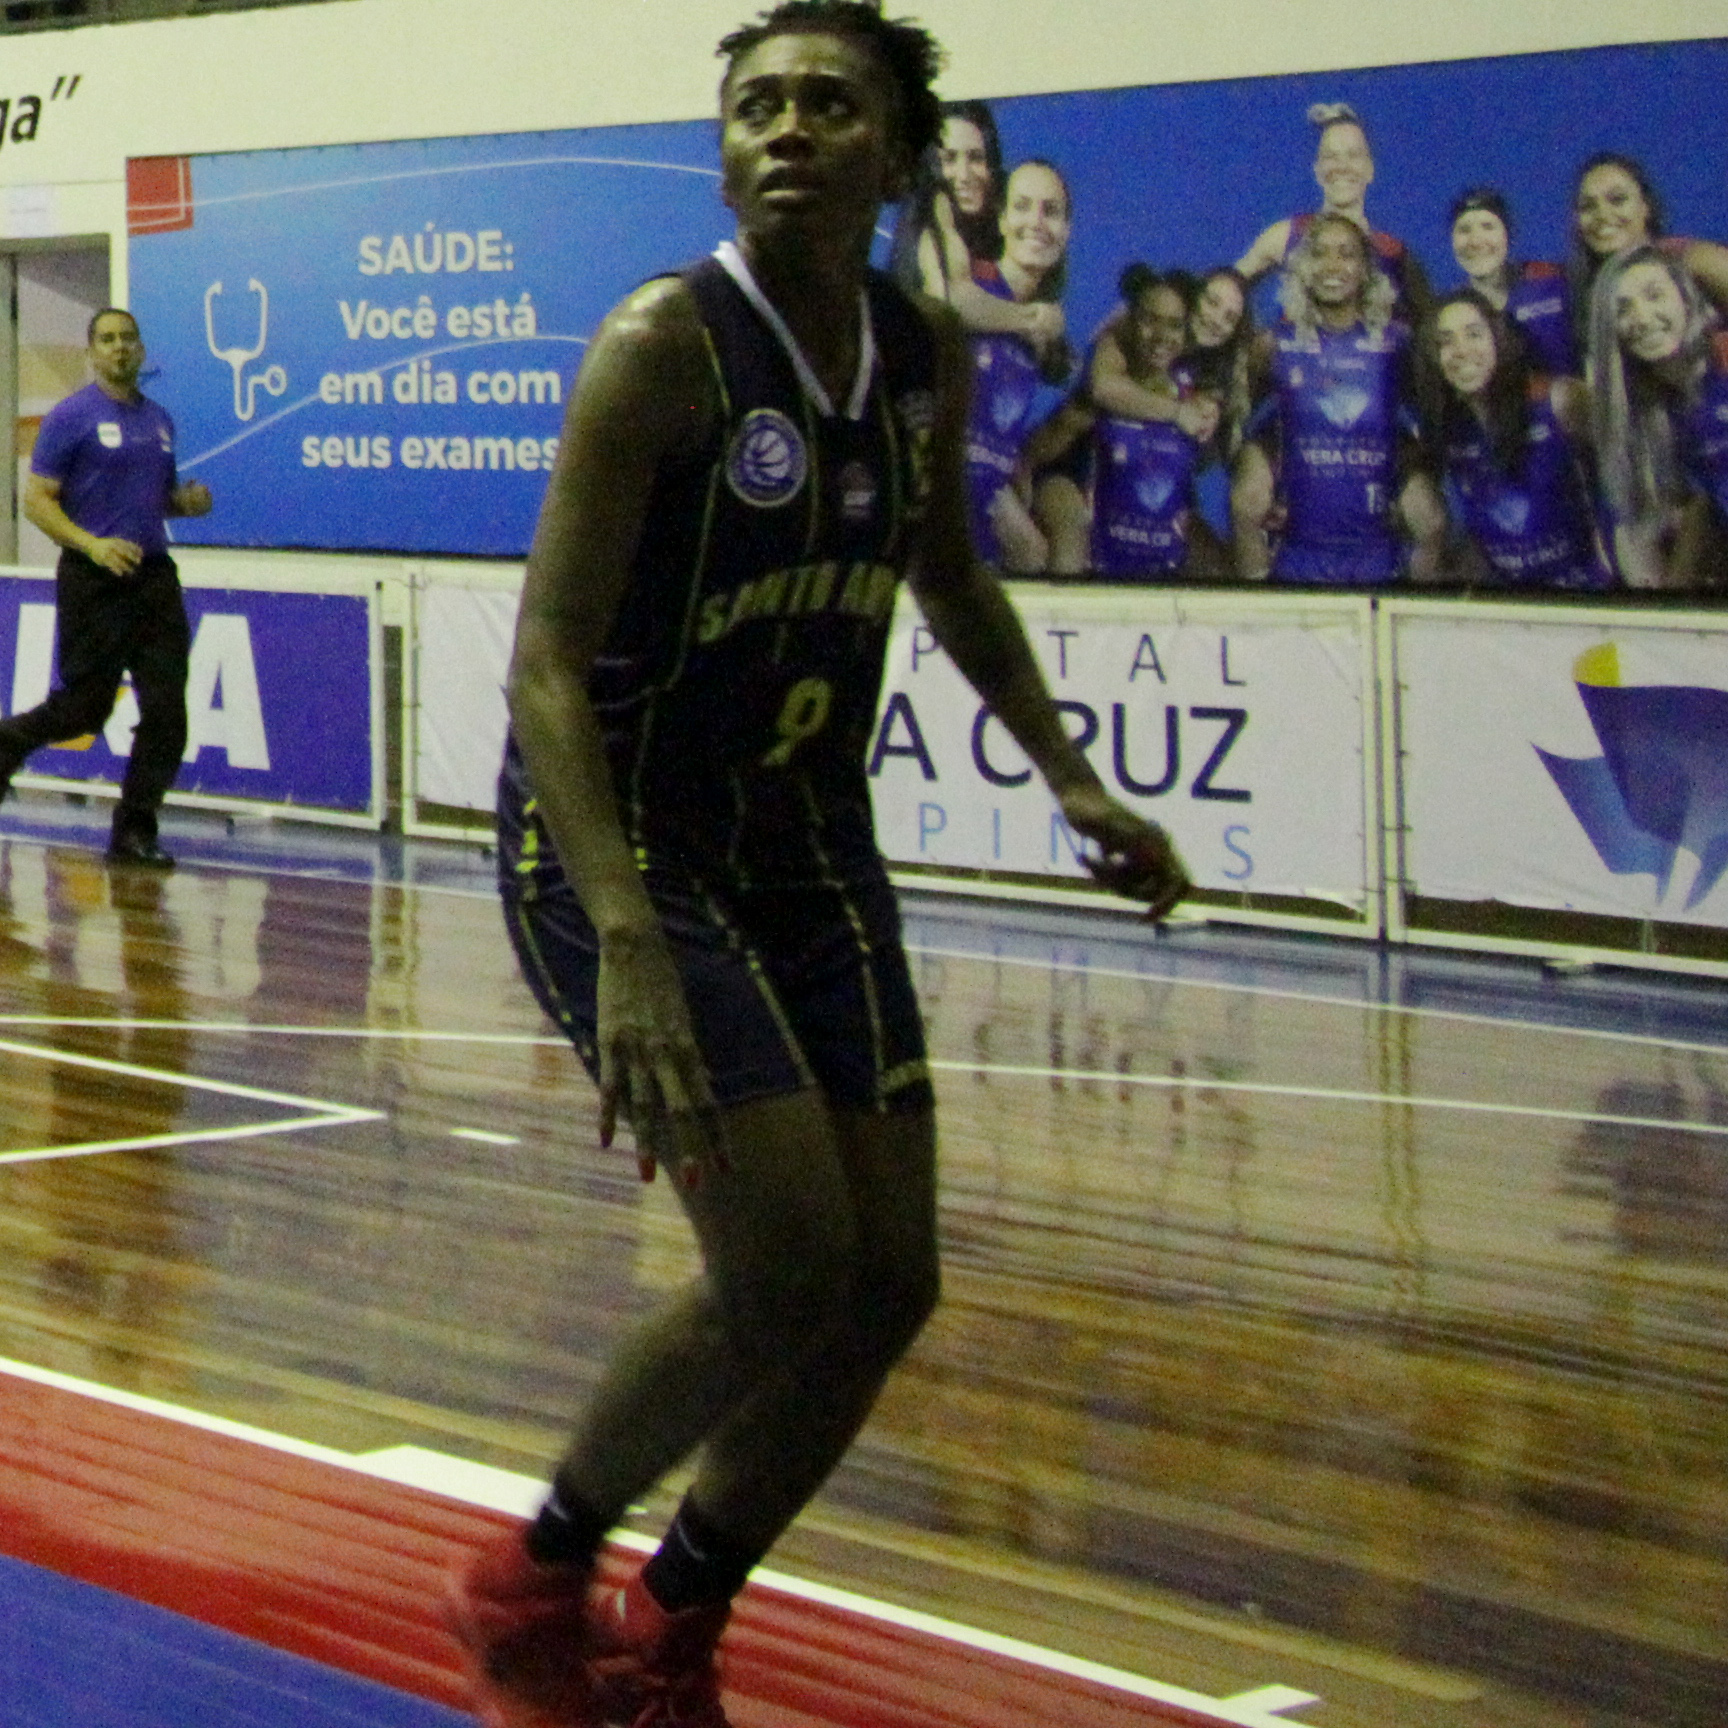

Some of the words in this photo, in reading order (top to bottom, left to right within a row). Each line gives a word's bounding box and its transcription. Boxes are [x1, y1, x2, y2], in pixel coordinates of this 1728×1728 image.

[357, 221, 514, 277] SAÚDE:
[338, 294, 438, 341] Você
[446, 291, 538, 339] está
[319, 372, 384, 404] em
[393, 359, 458, 404] dia
[466, 371, 562, 405] com
[301, 434, 393, 469] seus
[400, 434, 561, 472] exames
